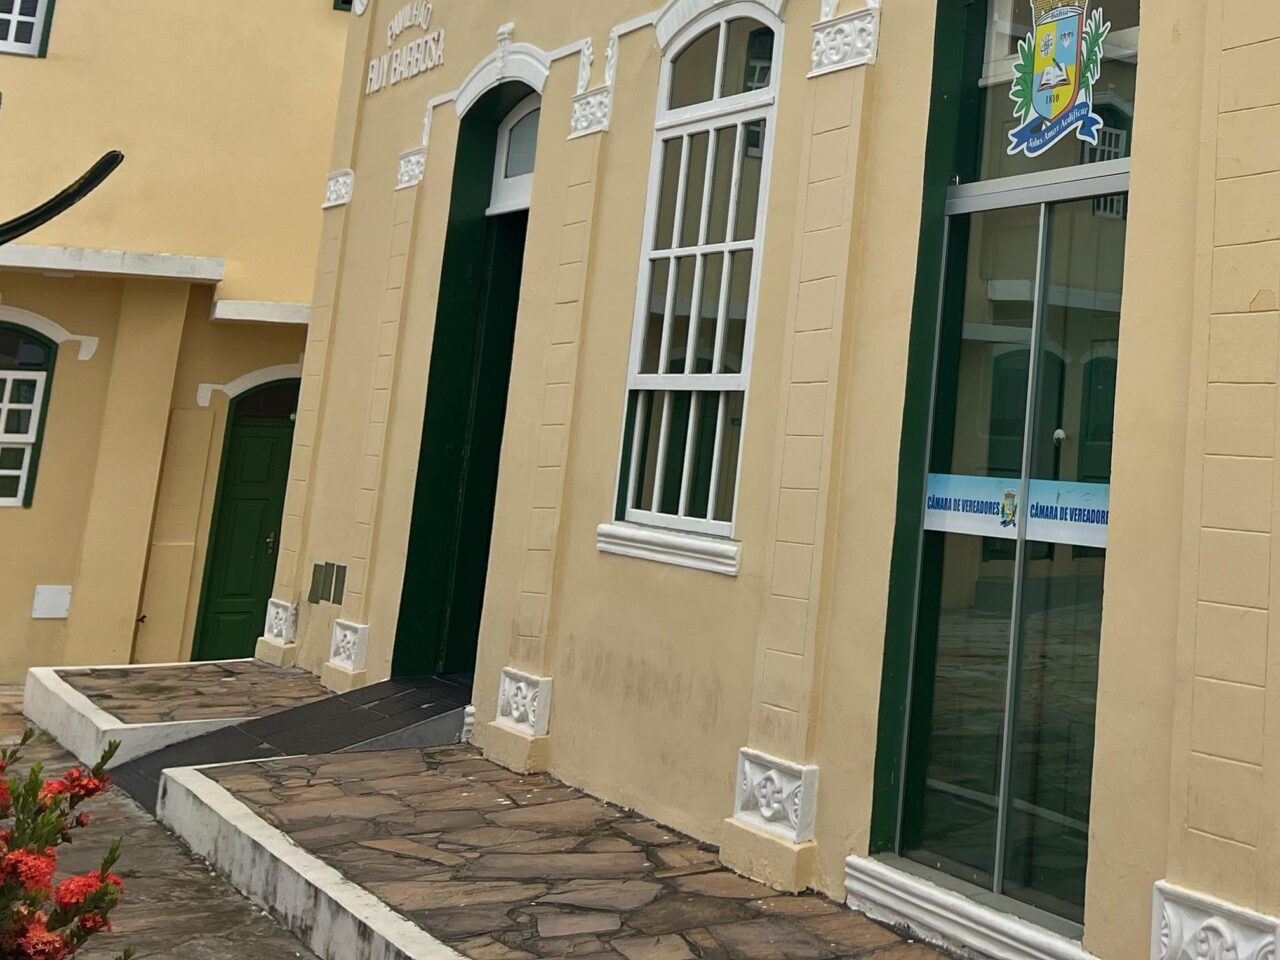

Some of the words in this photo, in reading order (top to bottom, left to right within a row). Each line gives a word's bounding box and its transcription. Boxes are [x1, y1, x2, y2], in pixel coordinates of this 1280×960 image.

[365, 51, 392, 95] RUY
[390, 27, 445, 85] BARBOSA
[927, 494, 952, 511] CÂMARA
[953, 498, 961, 512] DE
[961, 499, 1000, 516] VEREADORES
[1030, 501, 1059, 520] CÂMARA
[1059, 507, 1070, 522] DE
